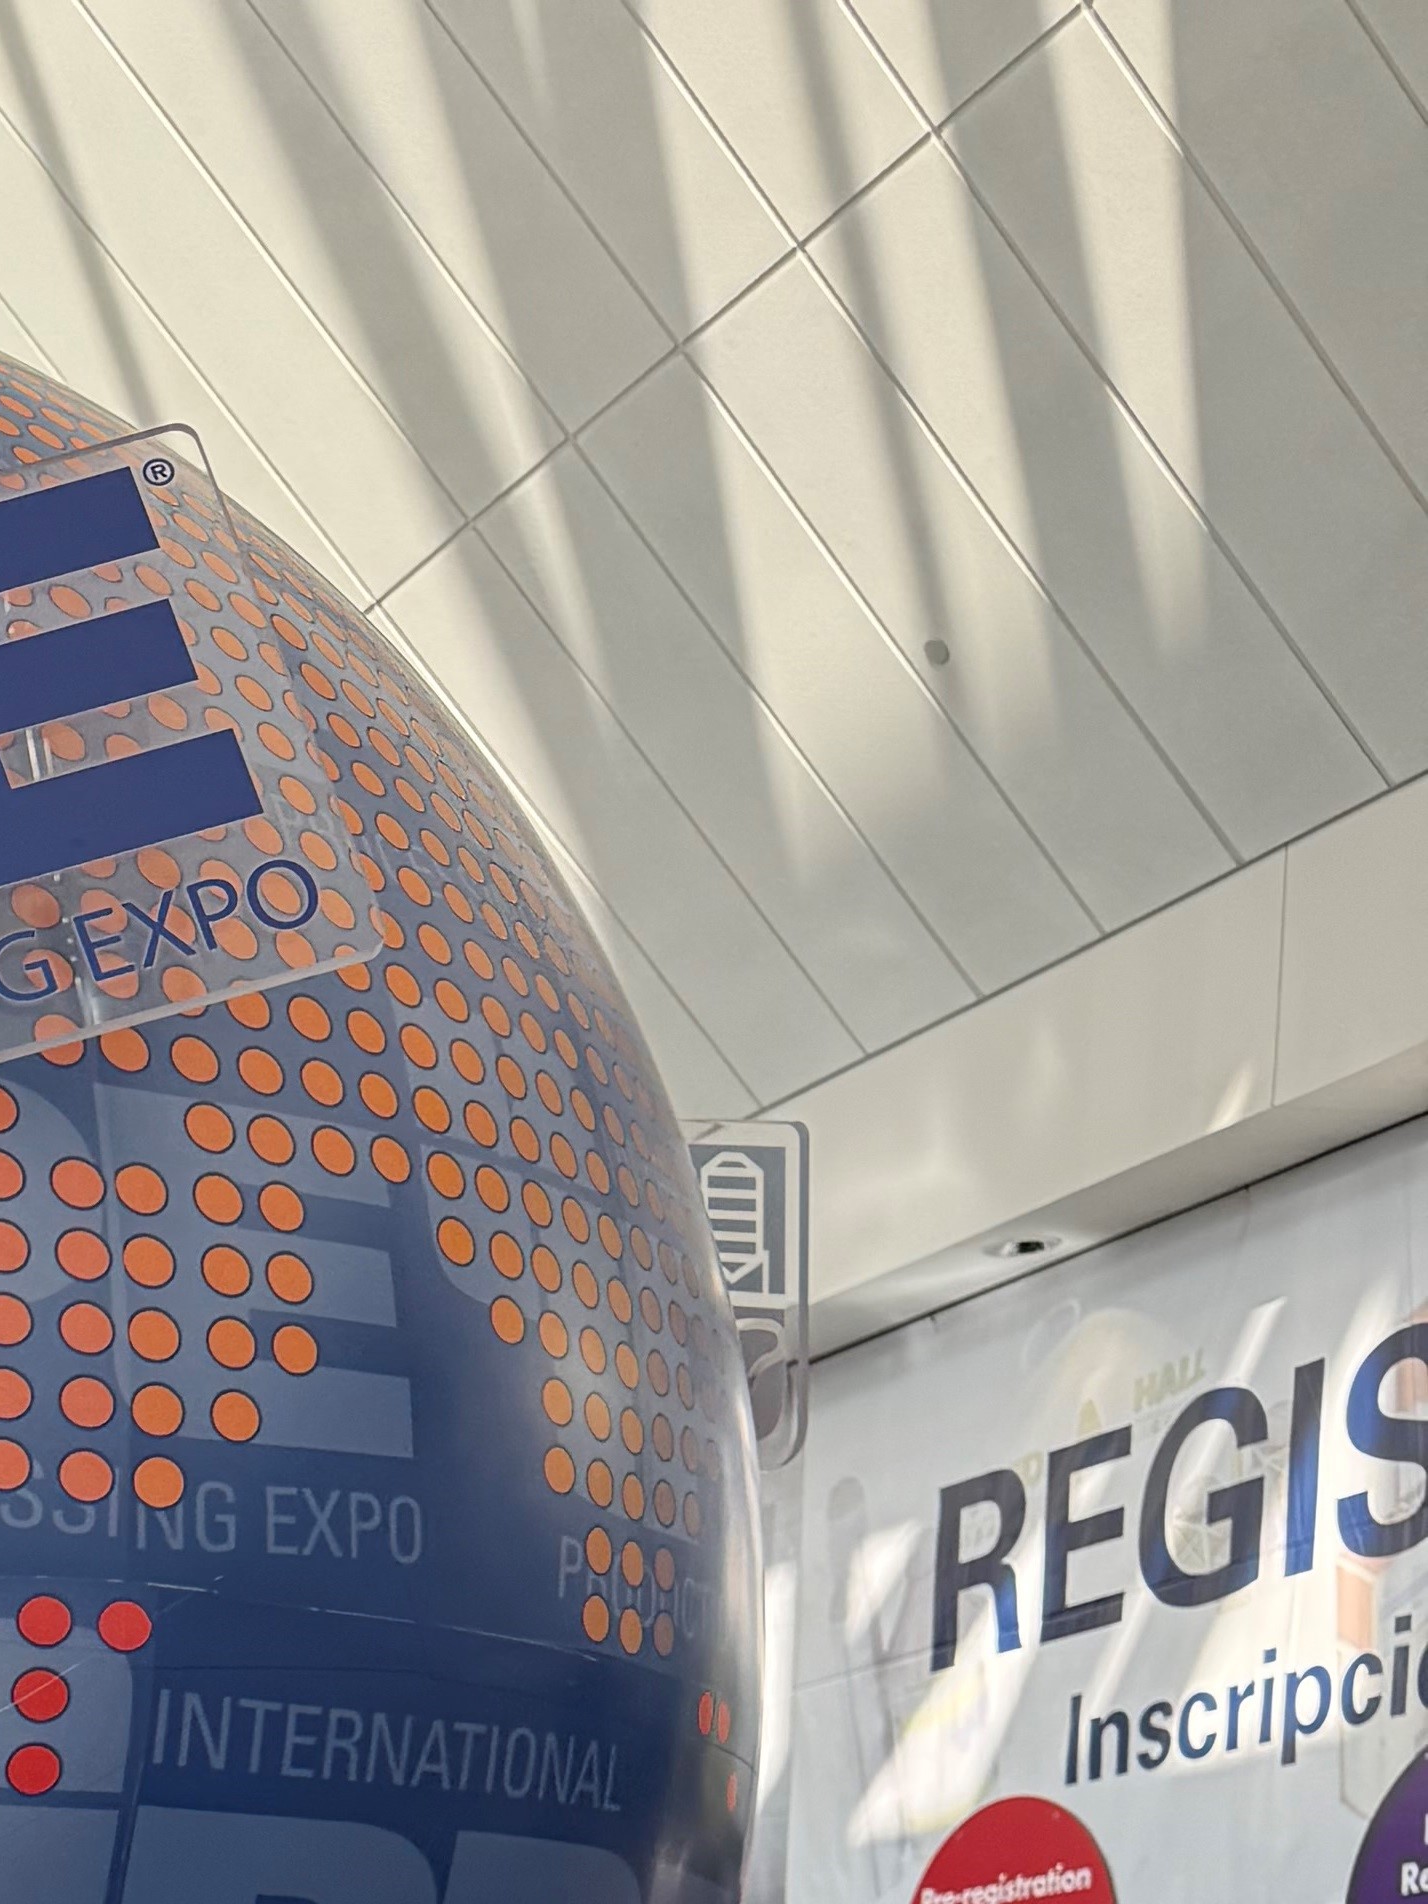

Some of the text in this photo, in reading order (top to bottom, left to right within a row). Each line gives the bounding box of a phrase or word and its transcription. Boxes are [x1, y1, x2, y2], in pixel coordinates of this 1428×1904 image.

[73, 858, 318, 978] EXPO
[266, 1484, 425, 1566] EXPO
[929, 1320, 1428, 1672] REGIS
[151, 1686, 620, 1812] INTERNATIONAL
